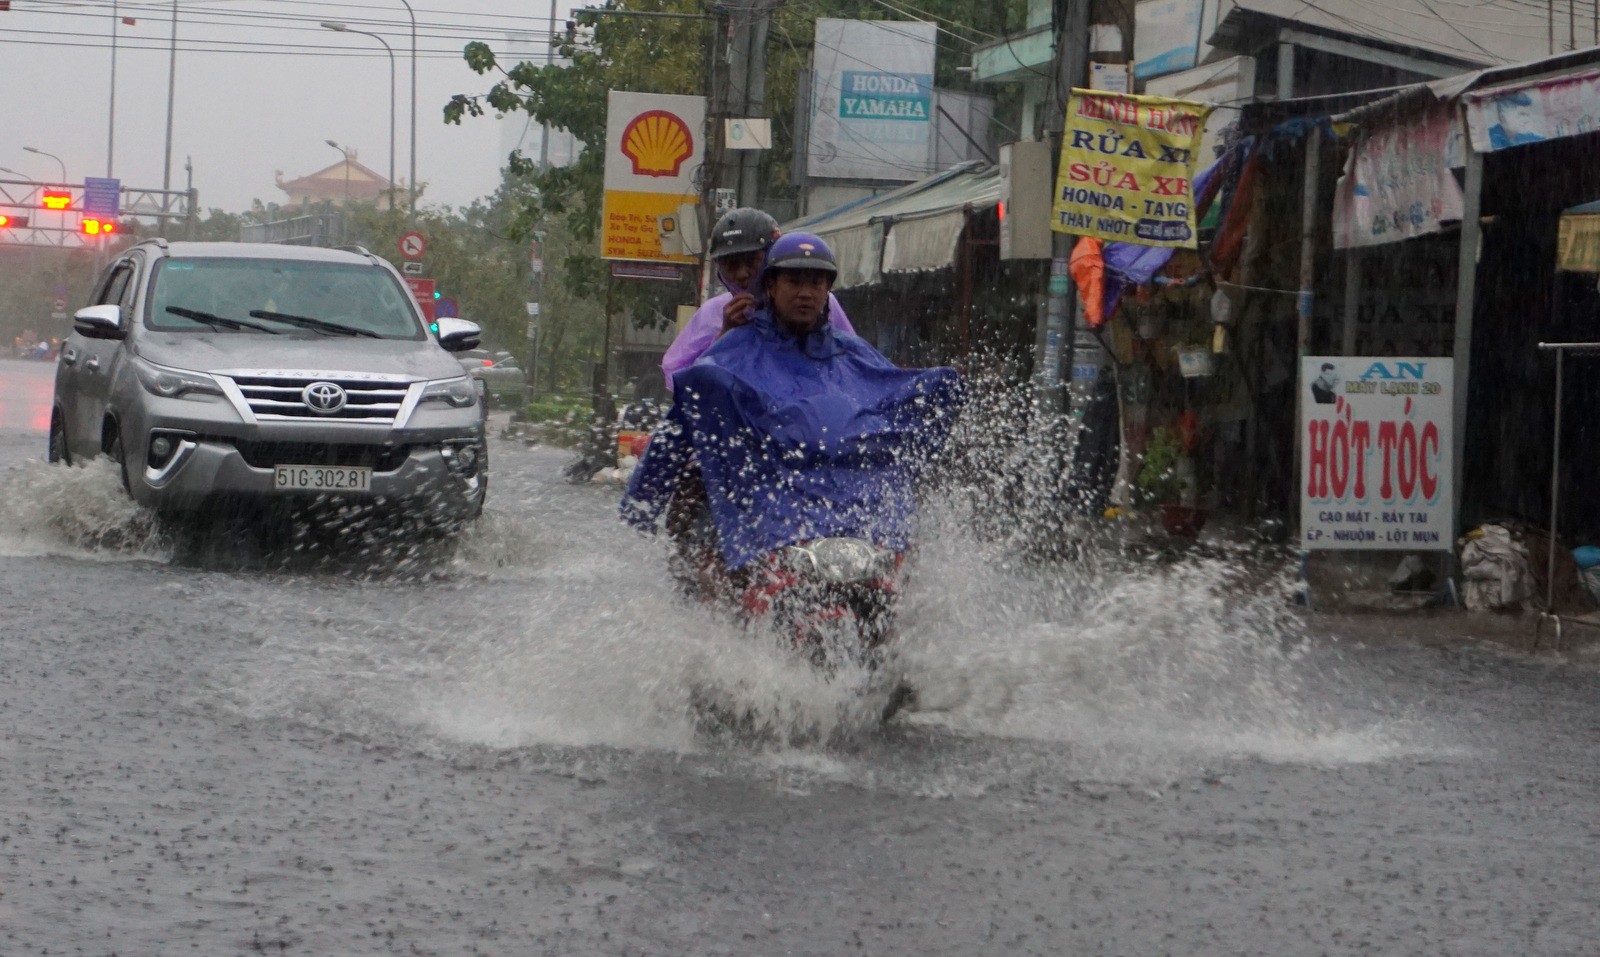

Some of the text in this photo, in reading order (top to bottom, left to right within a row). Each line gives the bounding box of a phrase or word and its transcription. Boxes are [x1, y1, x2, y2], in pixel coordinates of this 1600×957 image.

[851, 75, 920, 94] HONDA
[843, 98, 927, 118] YAMAHA
[1070, 127, 1148, 160] RỬA
[1069, 160, 1141, 192] SỬA
[1062, 186, 1125, 211] HONDA
[1059, 210, 1093, 229] THAY
[608, 235, 641, 244] HONDA
[608, 247, 625, 255] SYM
[1359, 362, 1428, 380] AN
[1308, 395, 1439, 500] HỚT TÓC
[1408, 512, 1428, 523] TAI
[1333, 527, 1376, 543] NHUỘM
[1412, 530, 1440, 543] MỤN
